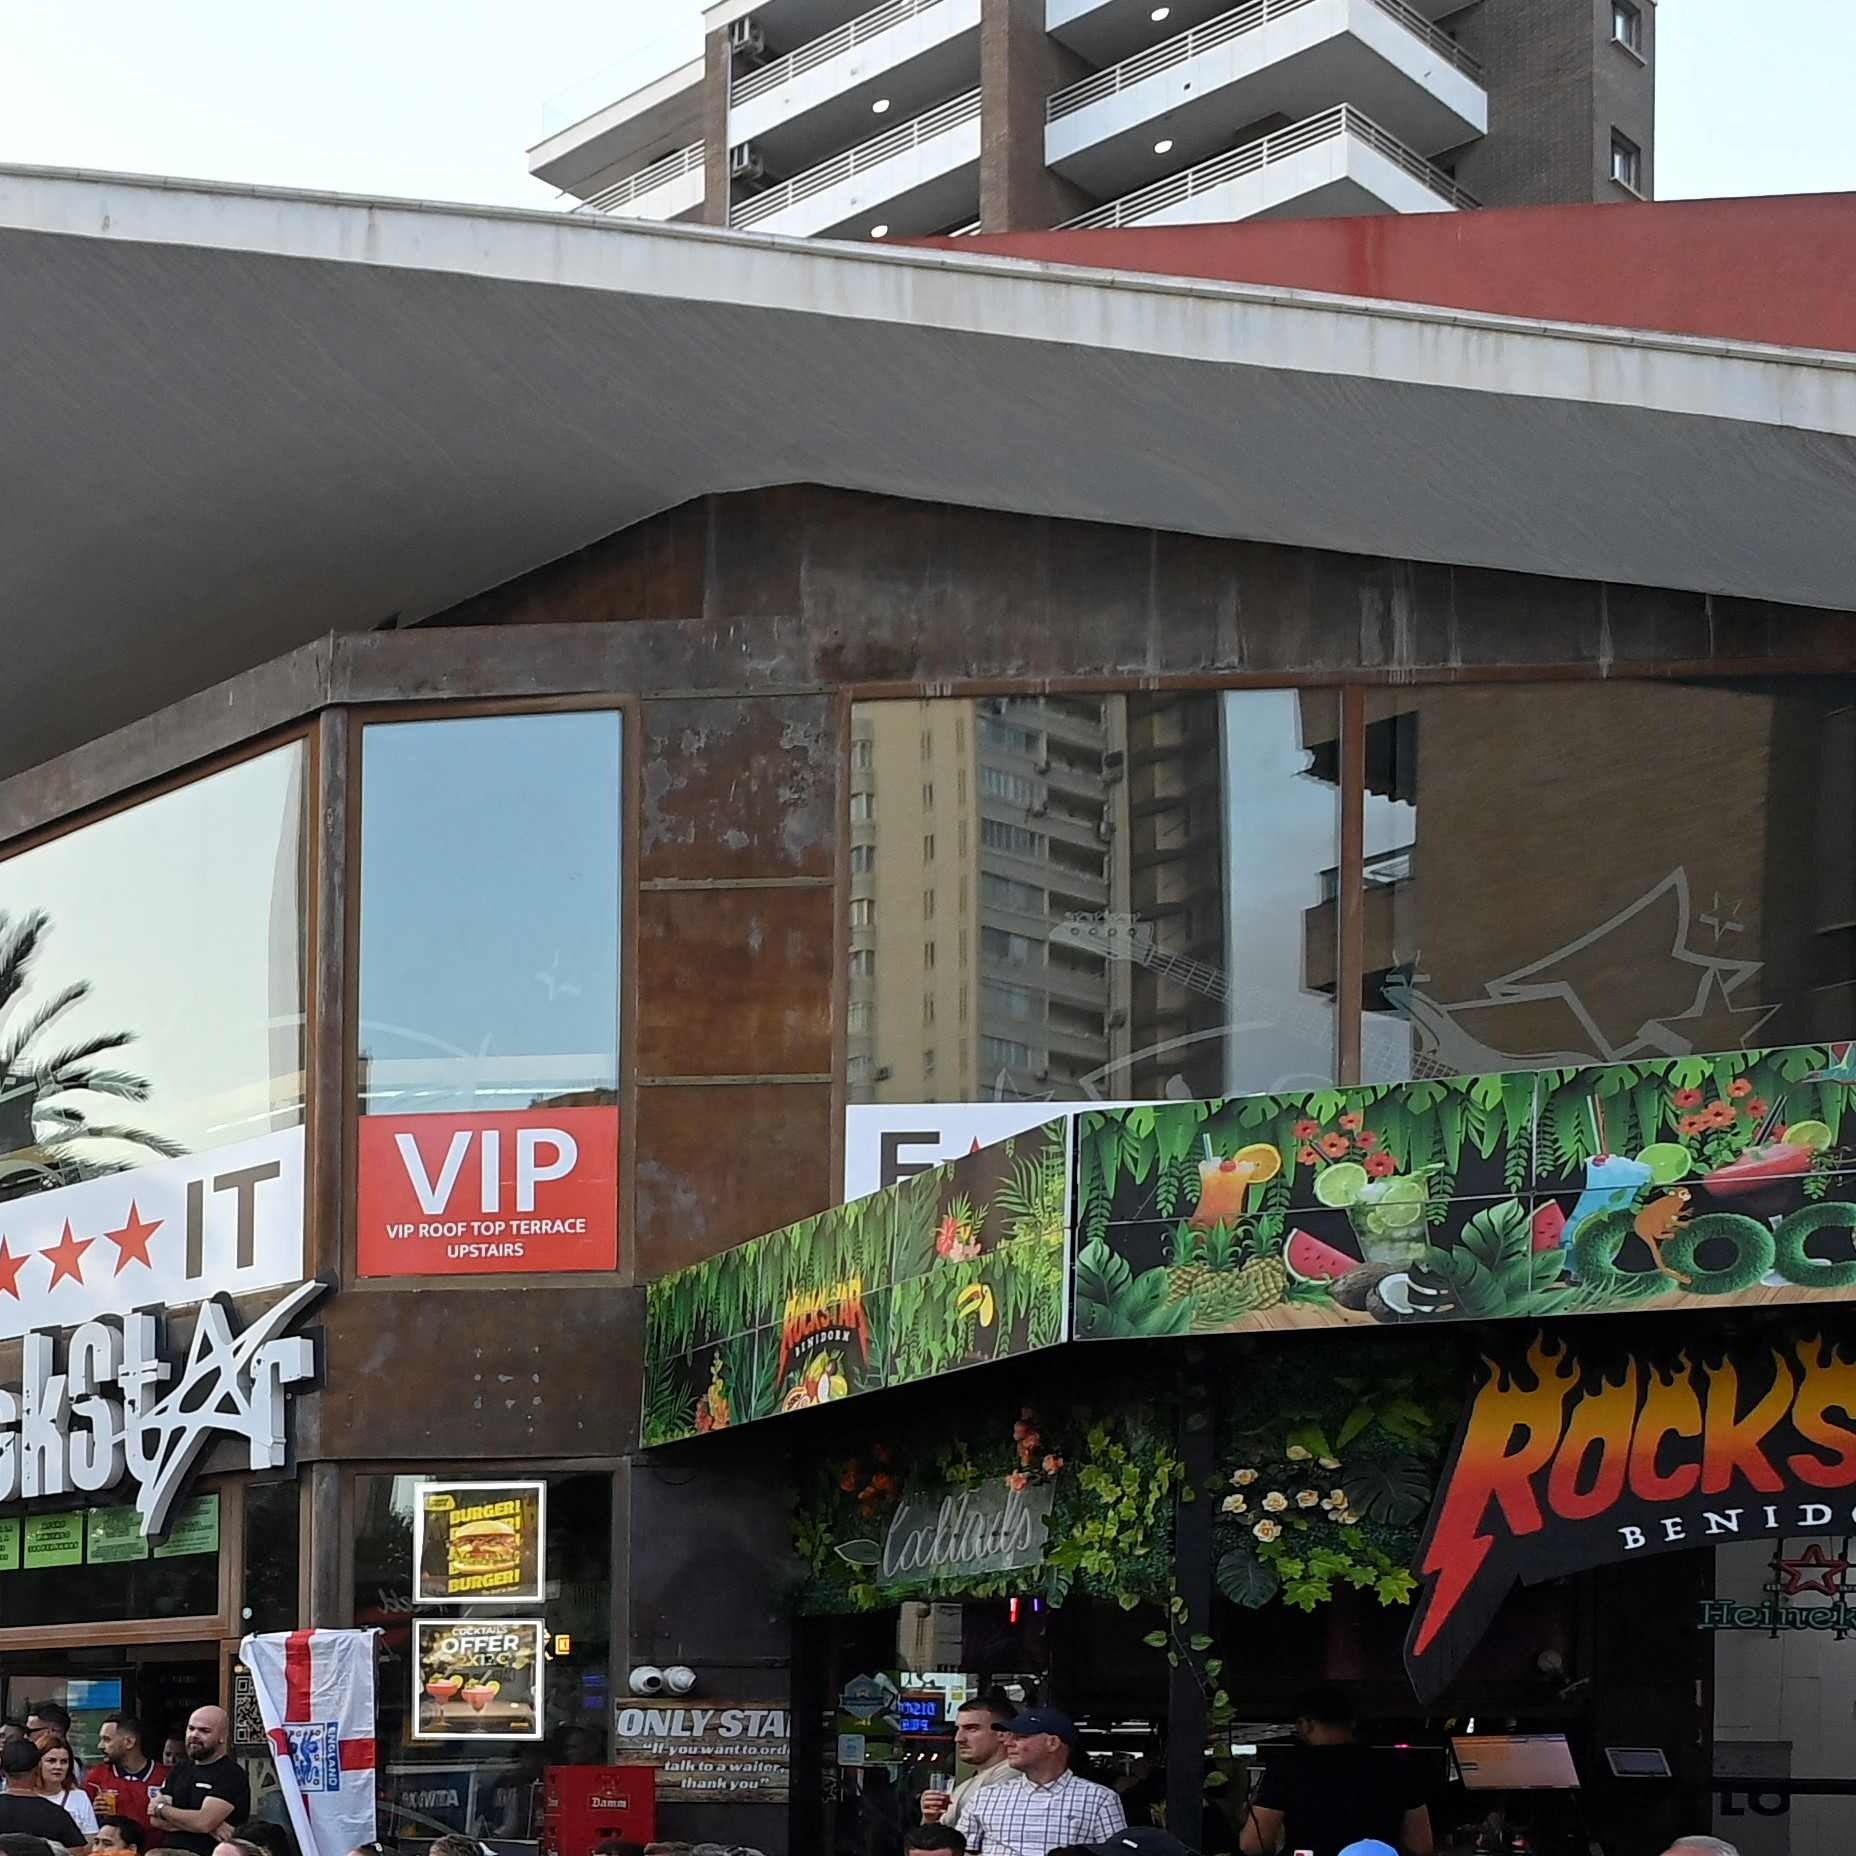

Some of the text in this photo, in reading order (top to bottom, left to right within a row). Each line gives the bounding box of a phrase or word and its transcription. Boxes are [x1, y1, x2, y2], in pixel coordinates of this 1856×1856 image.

[393, 1127, 579, 1216] VIP
[386, 1218, 586, 1240] VIP ROOF TOP TERRACE
[446, 1242, 524, 1259] UPSTAIRS
[449, 1499, 521, 1525] BURGER!
[1617, 1501, 1856, 1551] BENID
[448, 1568, 520, 1593] BURGER!
[451, 1625, 508, 1637] COCKTAILS
[441, 1634, 520, 1655] OFFER
[616, 1708, 791, 1739] ONLY STA
[327, 1722, 339, 1787] ENGLAND
[700, 1744, 741, 1755] want
[742, 1744, 761, 1755] to
[664, 1760, 696, 1772] talk
[698, 1761, 713, 1772] to
[716, 1763, 726, 1772] a
[681, 1777, 728, 1790] thank
[591, 1797, 627, 1808] Damm
